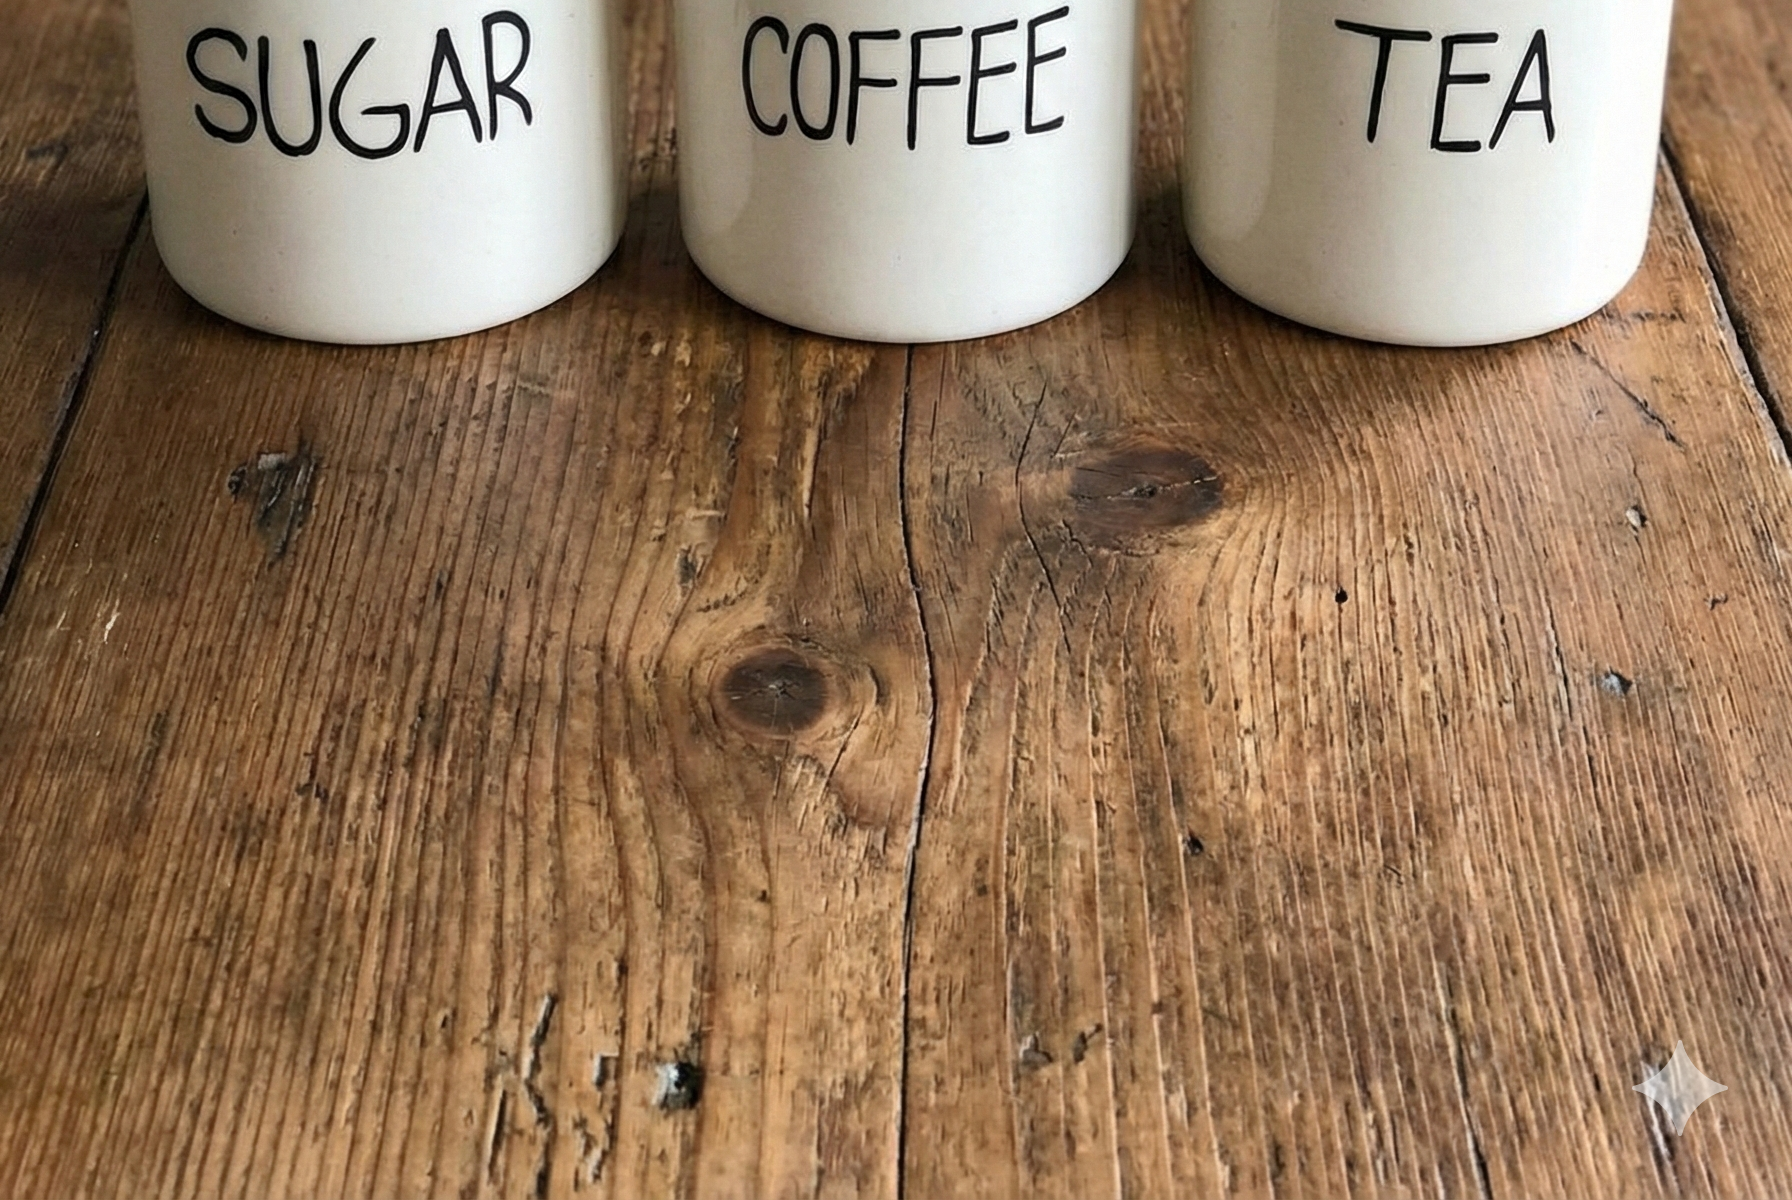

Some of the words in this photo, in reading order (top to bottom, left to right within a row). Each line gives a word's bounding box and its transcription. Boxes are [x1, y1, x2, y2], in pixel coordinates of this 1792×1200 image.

[186, 10, 533, 160] SUGAR
[741, 5, 1070, 151] COFFEE
[1333, 18, 1555, 153] TEA
